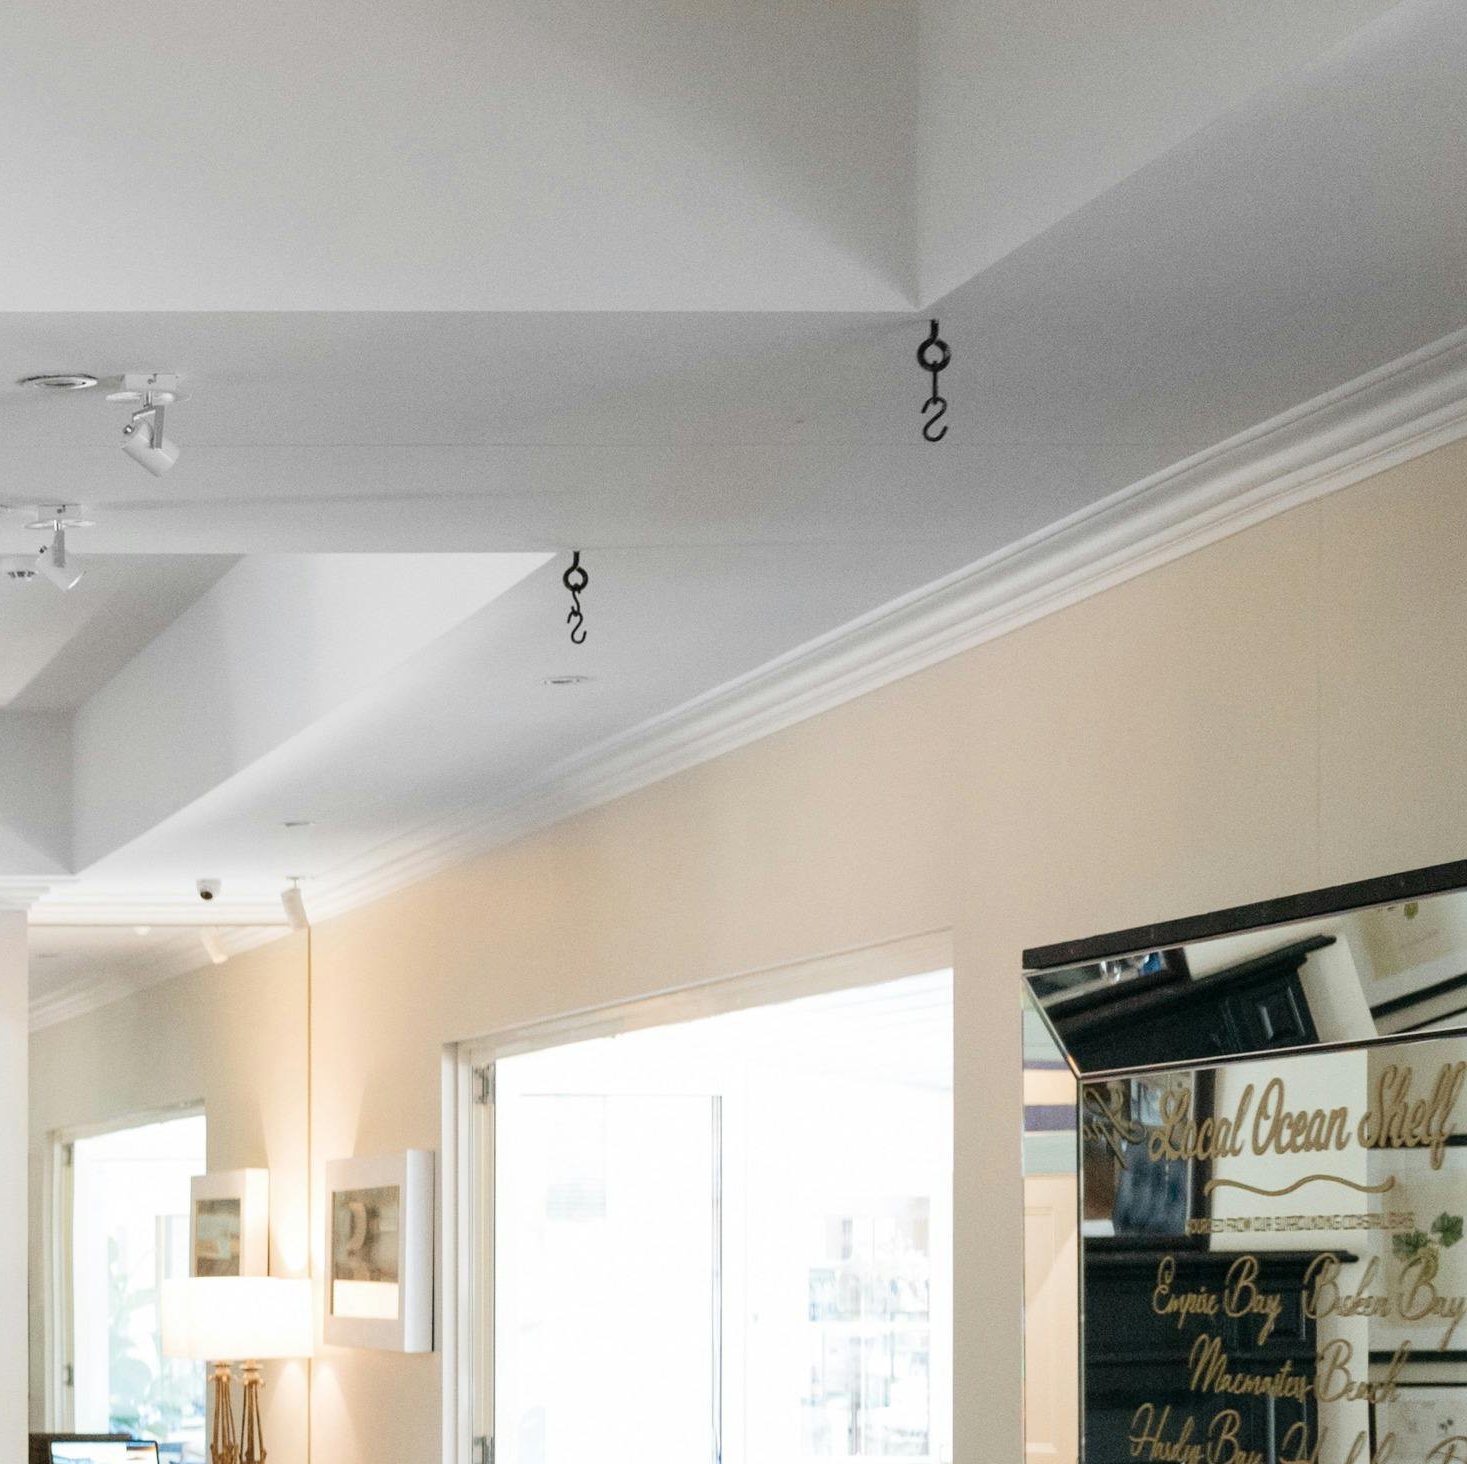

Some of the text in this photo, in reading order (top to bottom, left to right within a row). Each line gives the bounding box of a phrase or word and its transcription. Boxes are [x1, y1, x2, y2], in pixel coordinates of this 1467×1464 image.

[1148, 1083, 1255, 1162] Local
[1252, 1076, 1353, 1156] Ocean
[1356, 1060, 1467, 1171] Shelf
[1152, 1255, 1219, 1330] Empire
[1224, 1255, 1283, 1346] Bay
[1399, 1254, 1467, 1351] Bay
[1314, 1338, 1413, 1404] Beach
